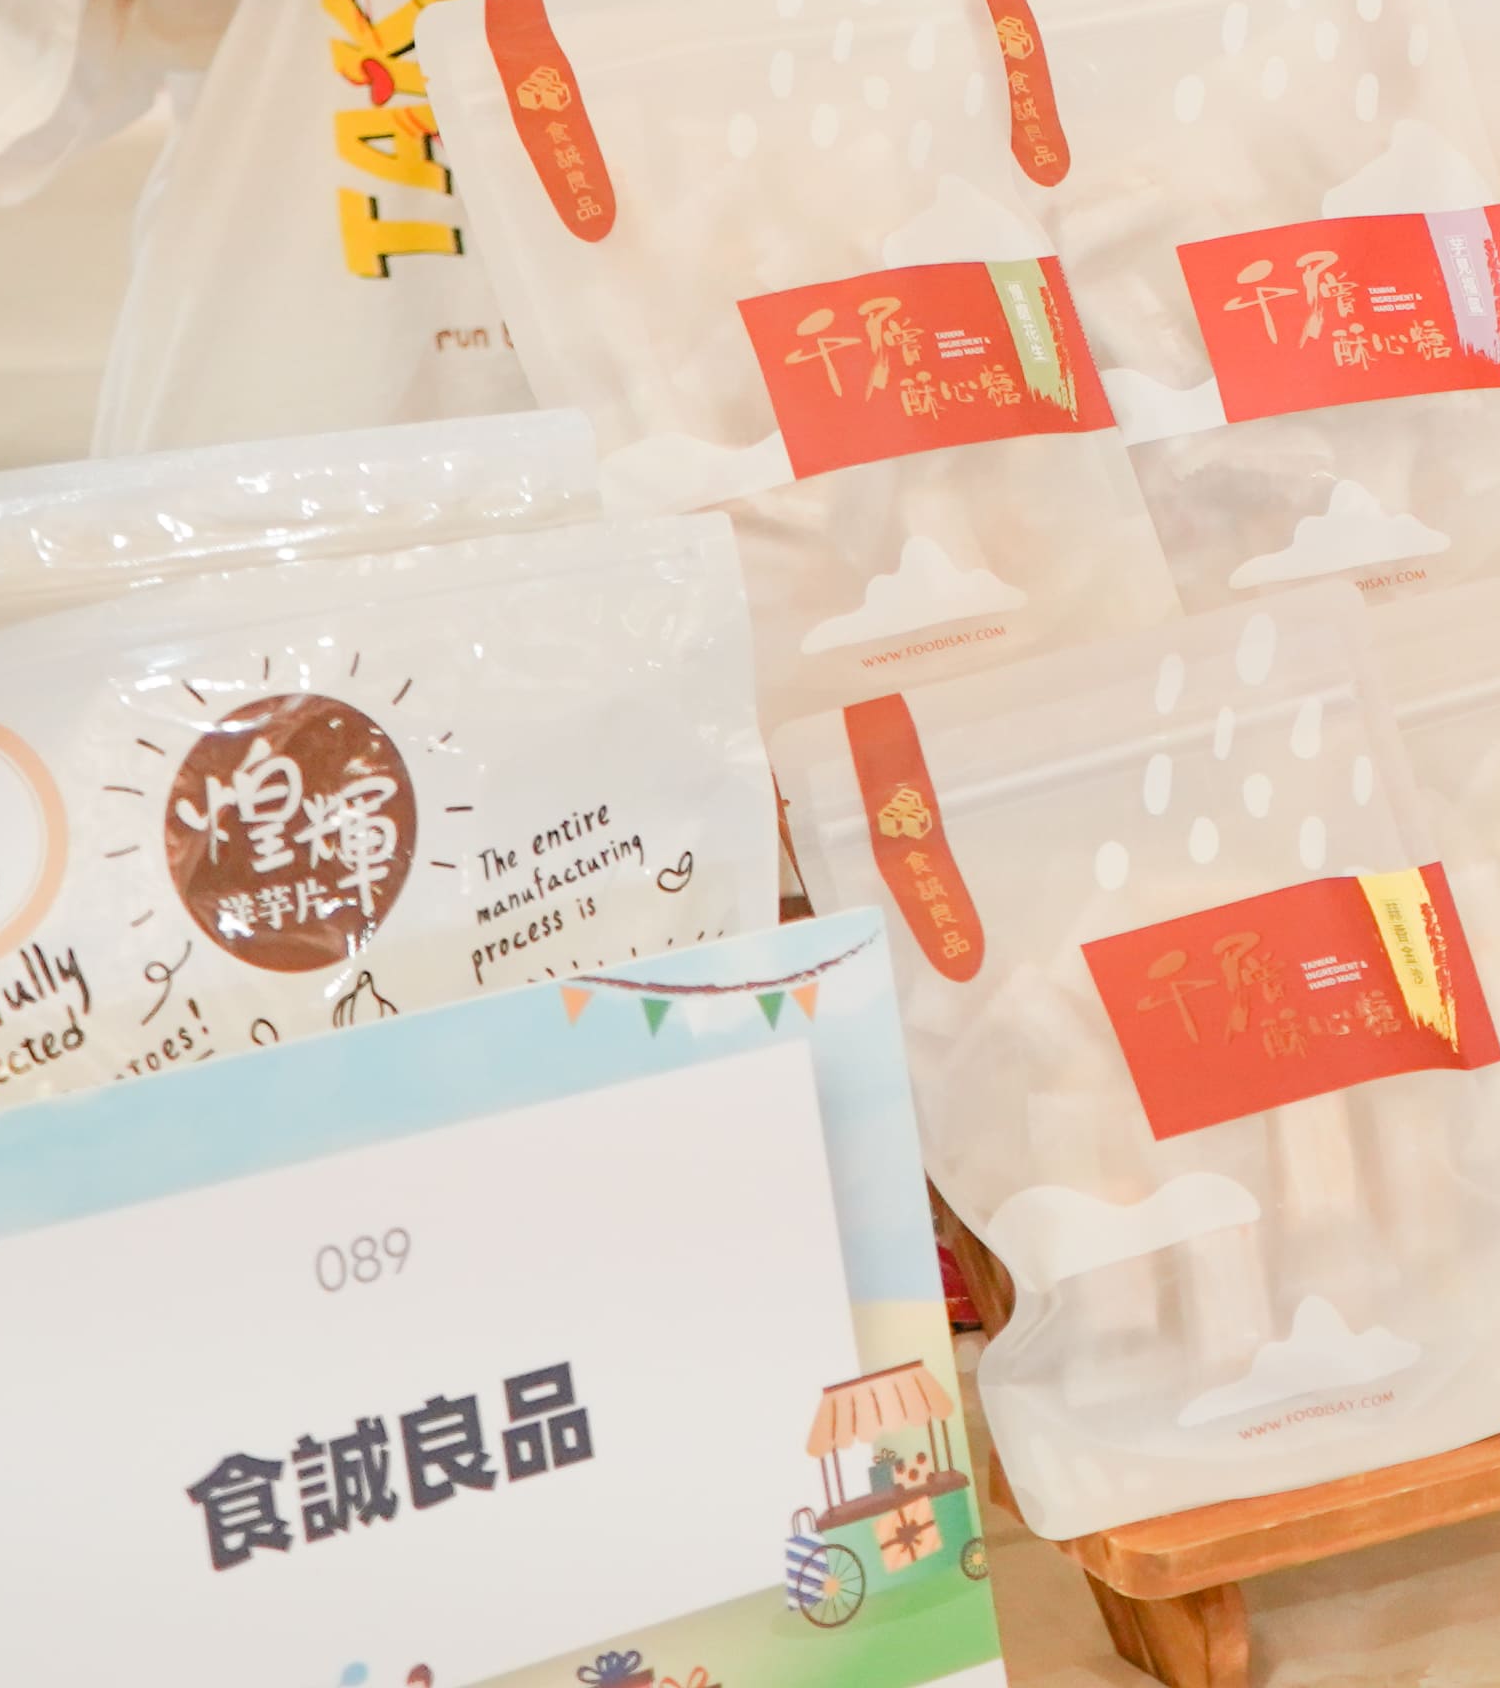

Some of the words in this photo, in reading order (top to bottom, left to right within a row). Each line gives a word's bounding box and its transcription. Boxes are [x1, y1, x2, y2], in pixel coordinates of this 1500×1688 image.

[176, 735, 398, 917] 煌輝
[477, 846, 519, 882] The
[531, 801, 612, 858] entire
[474, 831, 646, 926] manufacturing
[471, 912, 564, 985] process
[578, 896, 598, 923] is
[115, 997, 210, 1080] toes!
[312, 1226, 414, 1294] 089
[185, 1360, 597, 1573] 食誠良品
